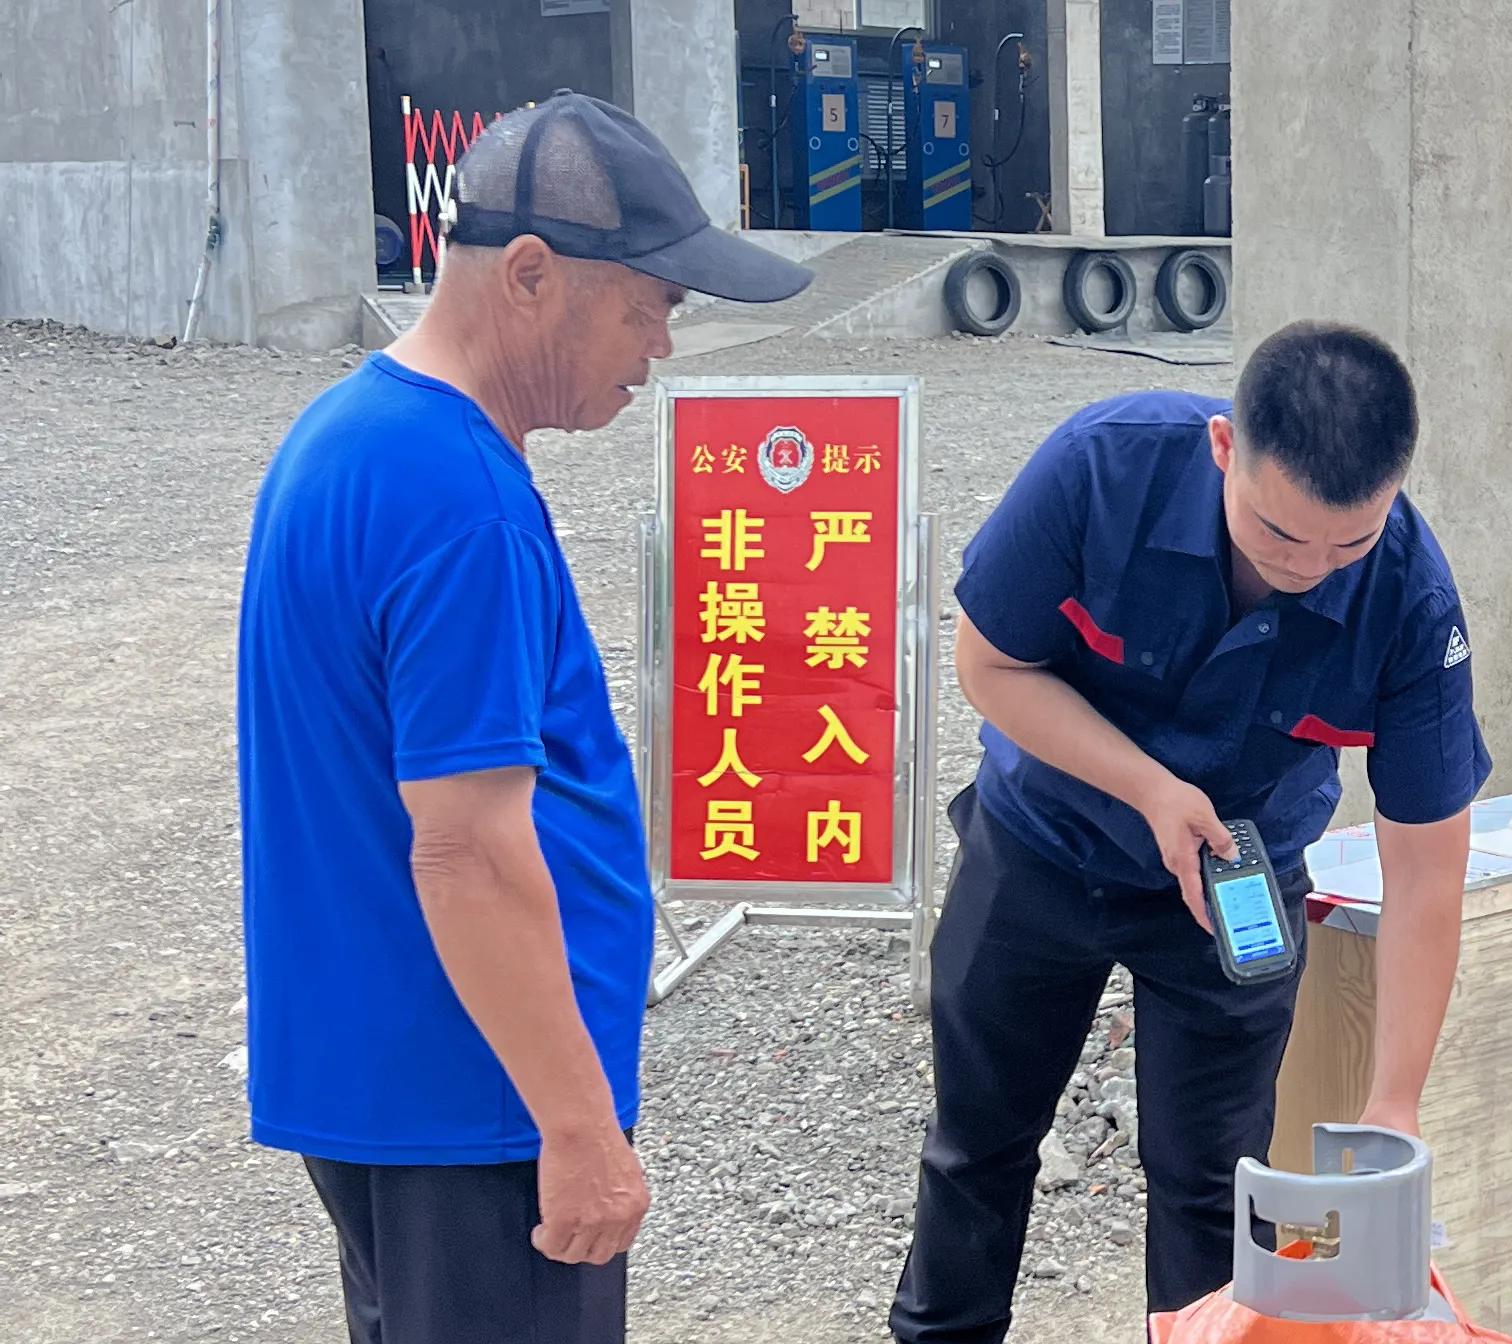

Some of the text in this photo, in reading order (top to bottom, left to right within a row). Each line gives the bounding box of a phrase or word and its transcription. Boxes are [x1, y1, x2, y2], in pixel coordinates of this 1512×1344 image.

[829, 107, 838, 123] 5
[941, 114, 949, 129] 7
[691, 443, 882, 475] 公安 提示
[697, 508, 767, 862] 非操作人员
[802, 510, 873, 864] 严禁入内
